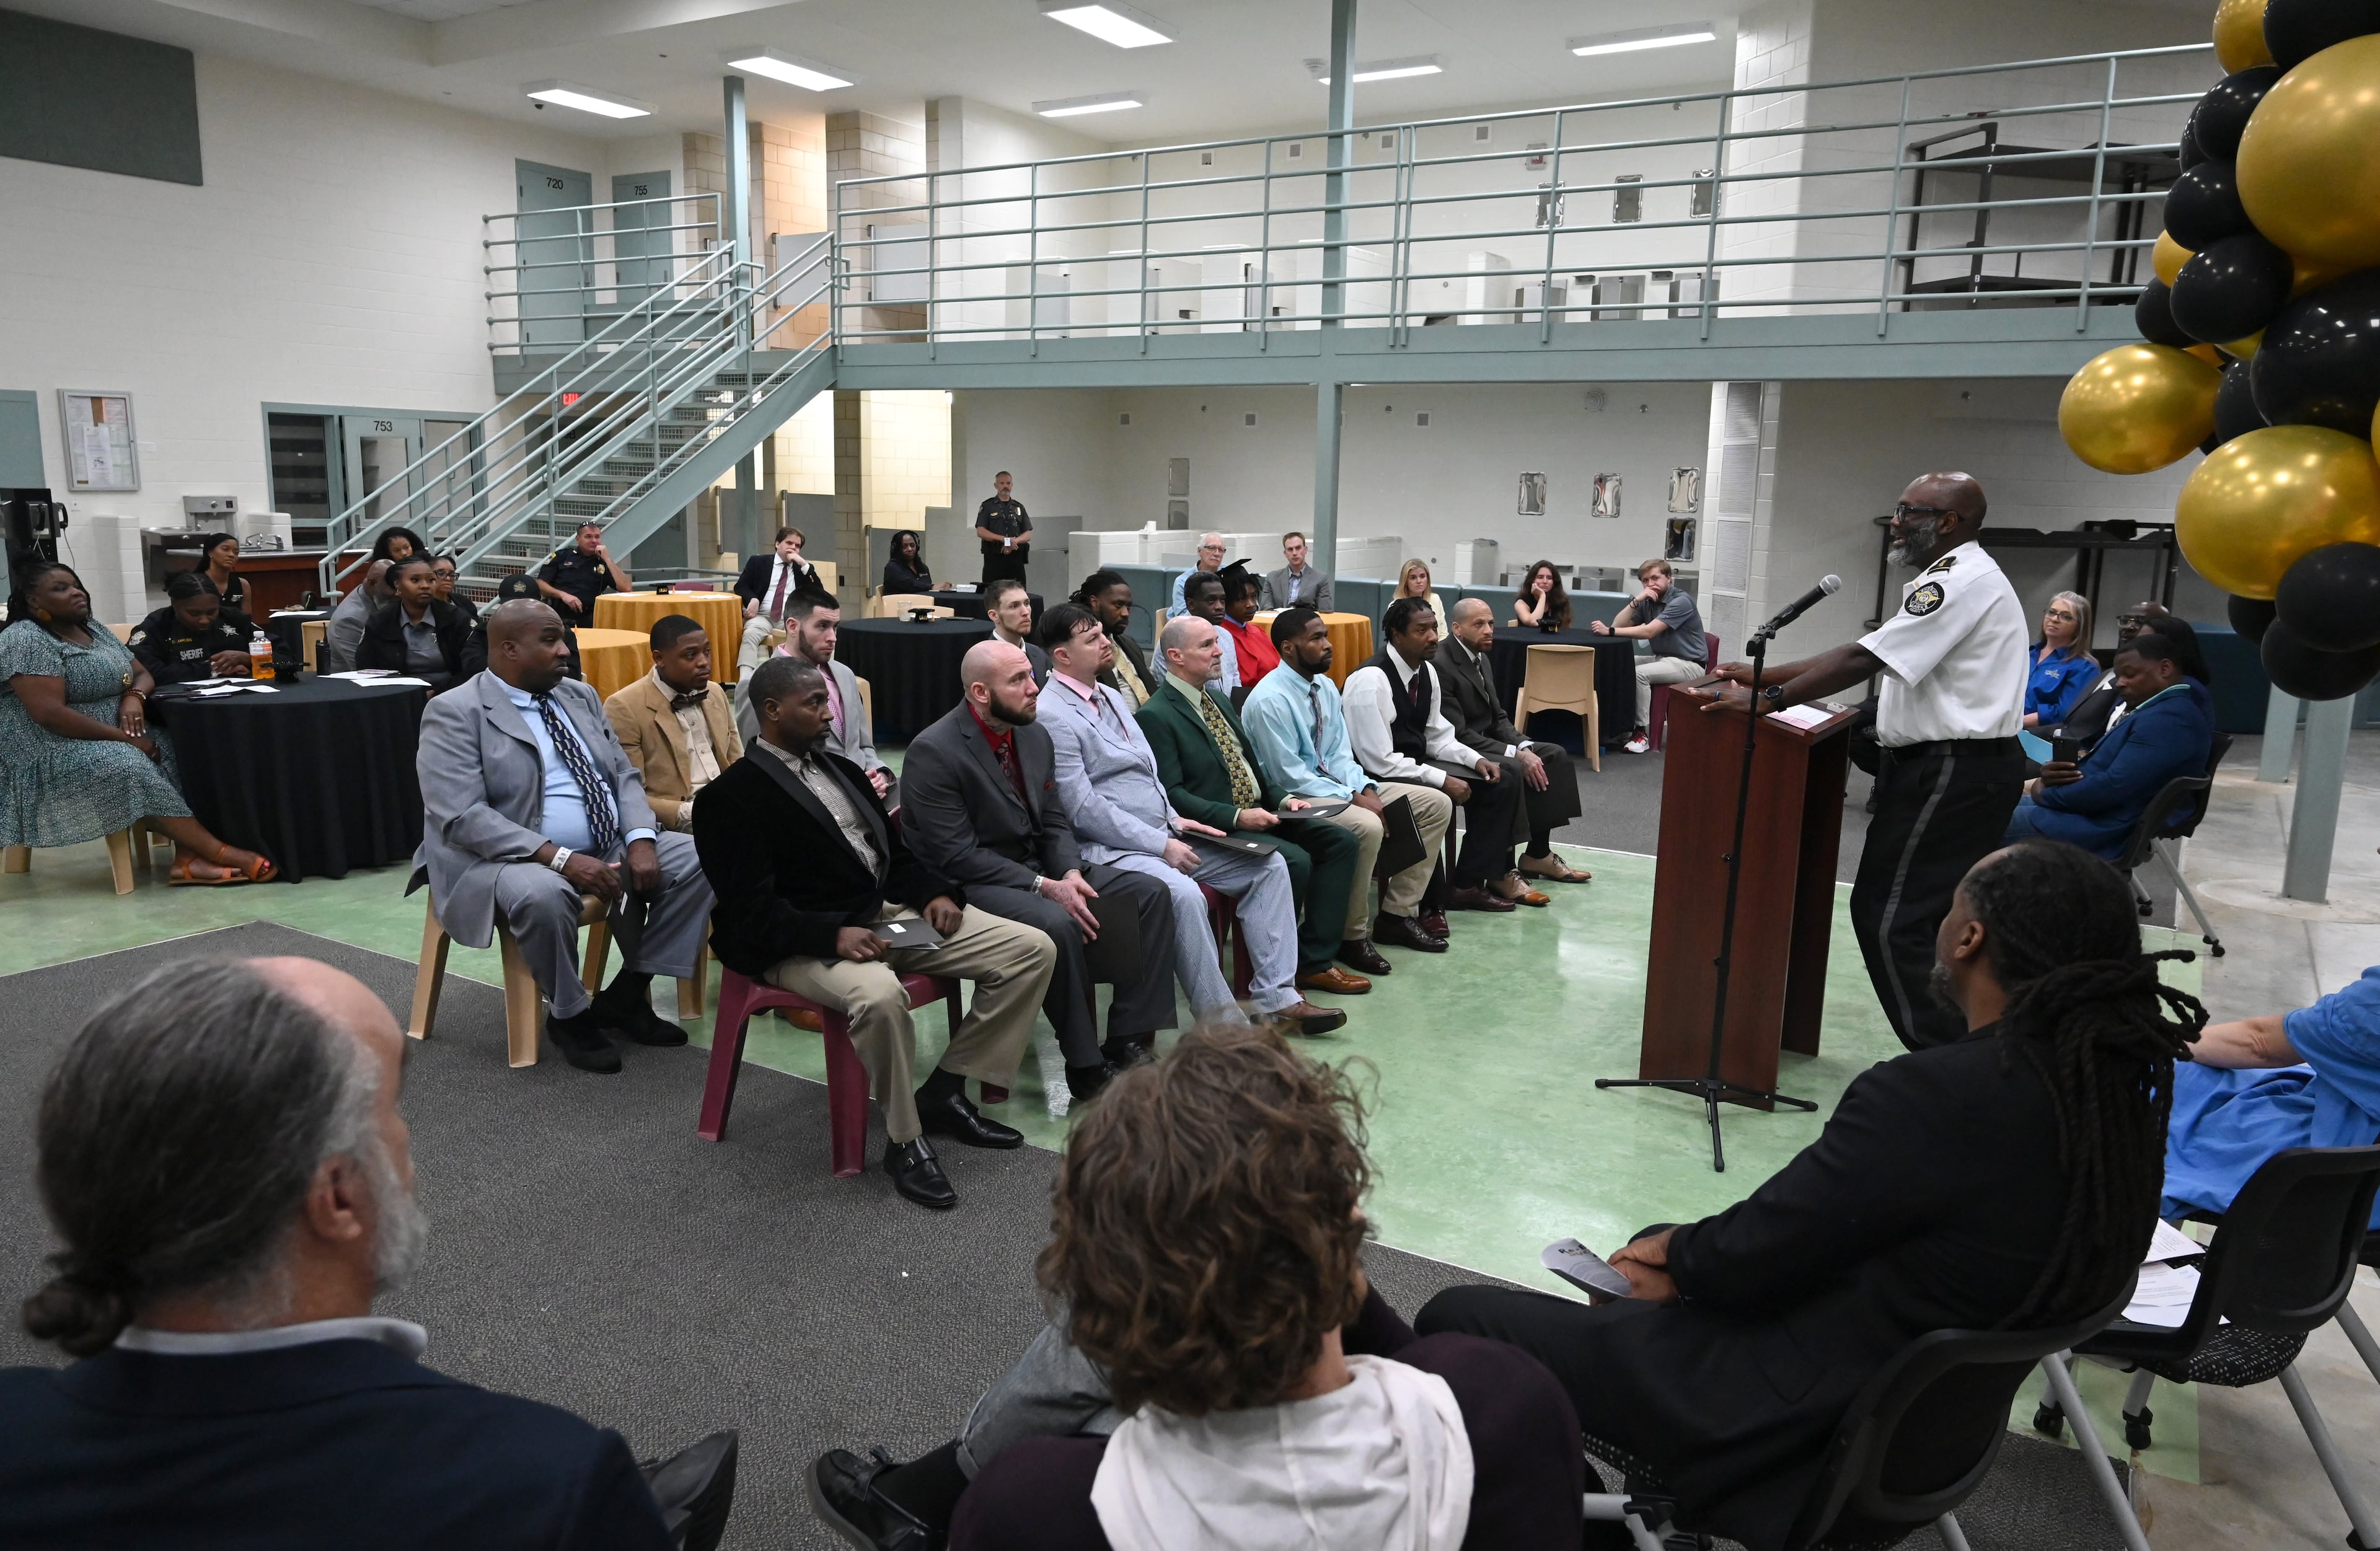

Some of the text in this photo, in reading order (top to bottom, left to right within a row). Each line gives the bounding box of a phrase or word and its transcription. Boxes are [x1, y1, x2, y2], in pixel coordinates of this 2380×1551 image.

[546, 177, 563, 190] 720
[635, 185, 648, 196] 755
[374, 421, 392, 432] 753
[180, 648, 204, 661] SHERIFF
